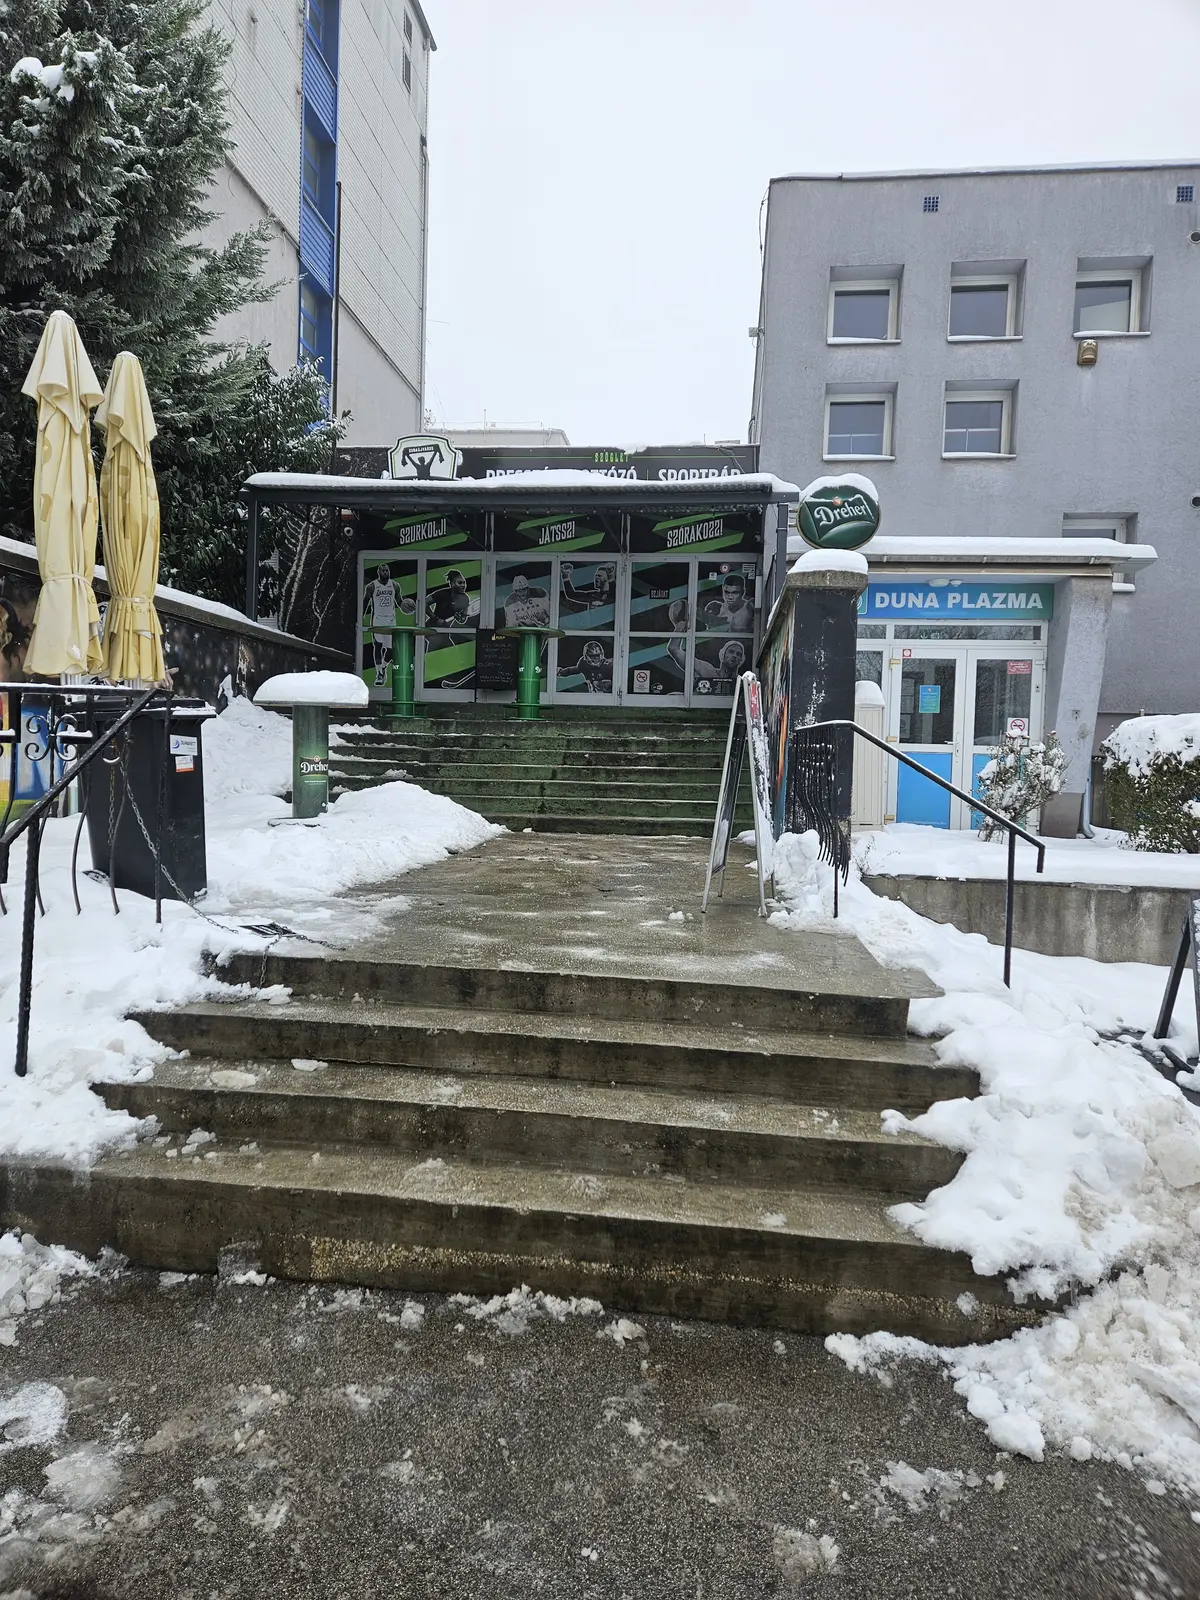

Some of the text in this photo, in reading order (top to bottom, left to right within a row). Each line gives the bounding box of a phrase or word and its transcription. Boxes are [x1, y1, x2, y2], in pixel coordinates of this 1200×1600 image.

[658, 465, 741, 482] SPORT
[813, 502, 867, 526] Dreher
[400, 518, 447, 545] SZURKOLJ!
[538, 520, 576, 545] JÁTSSZ!
[667, 519, 723, 547] SZÓRAKOZZ!
[380, 596, 391, 607] 23
[875, 592, 1043, 609] DUNA PLAZMA
